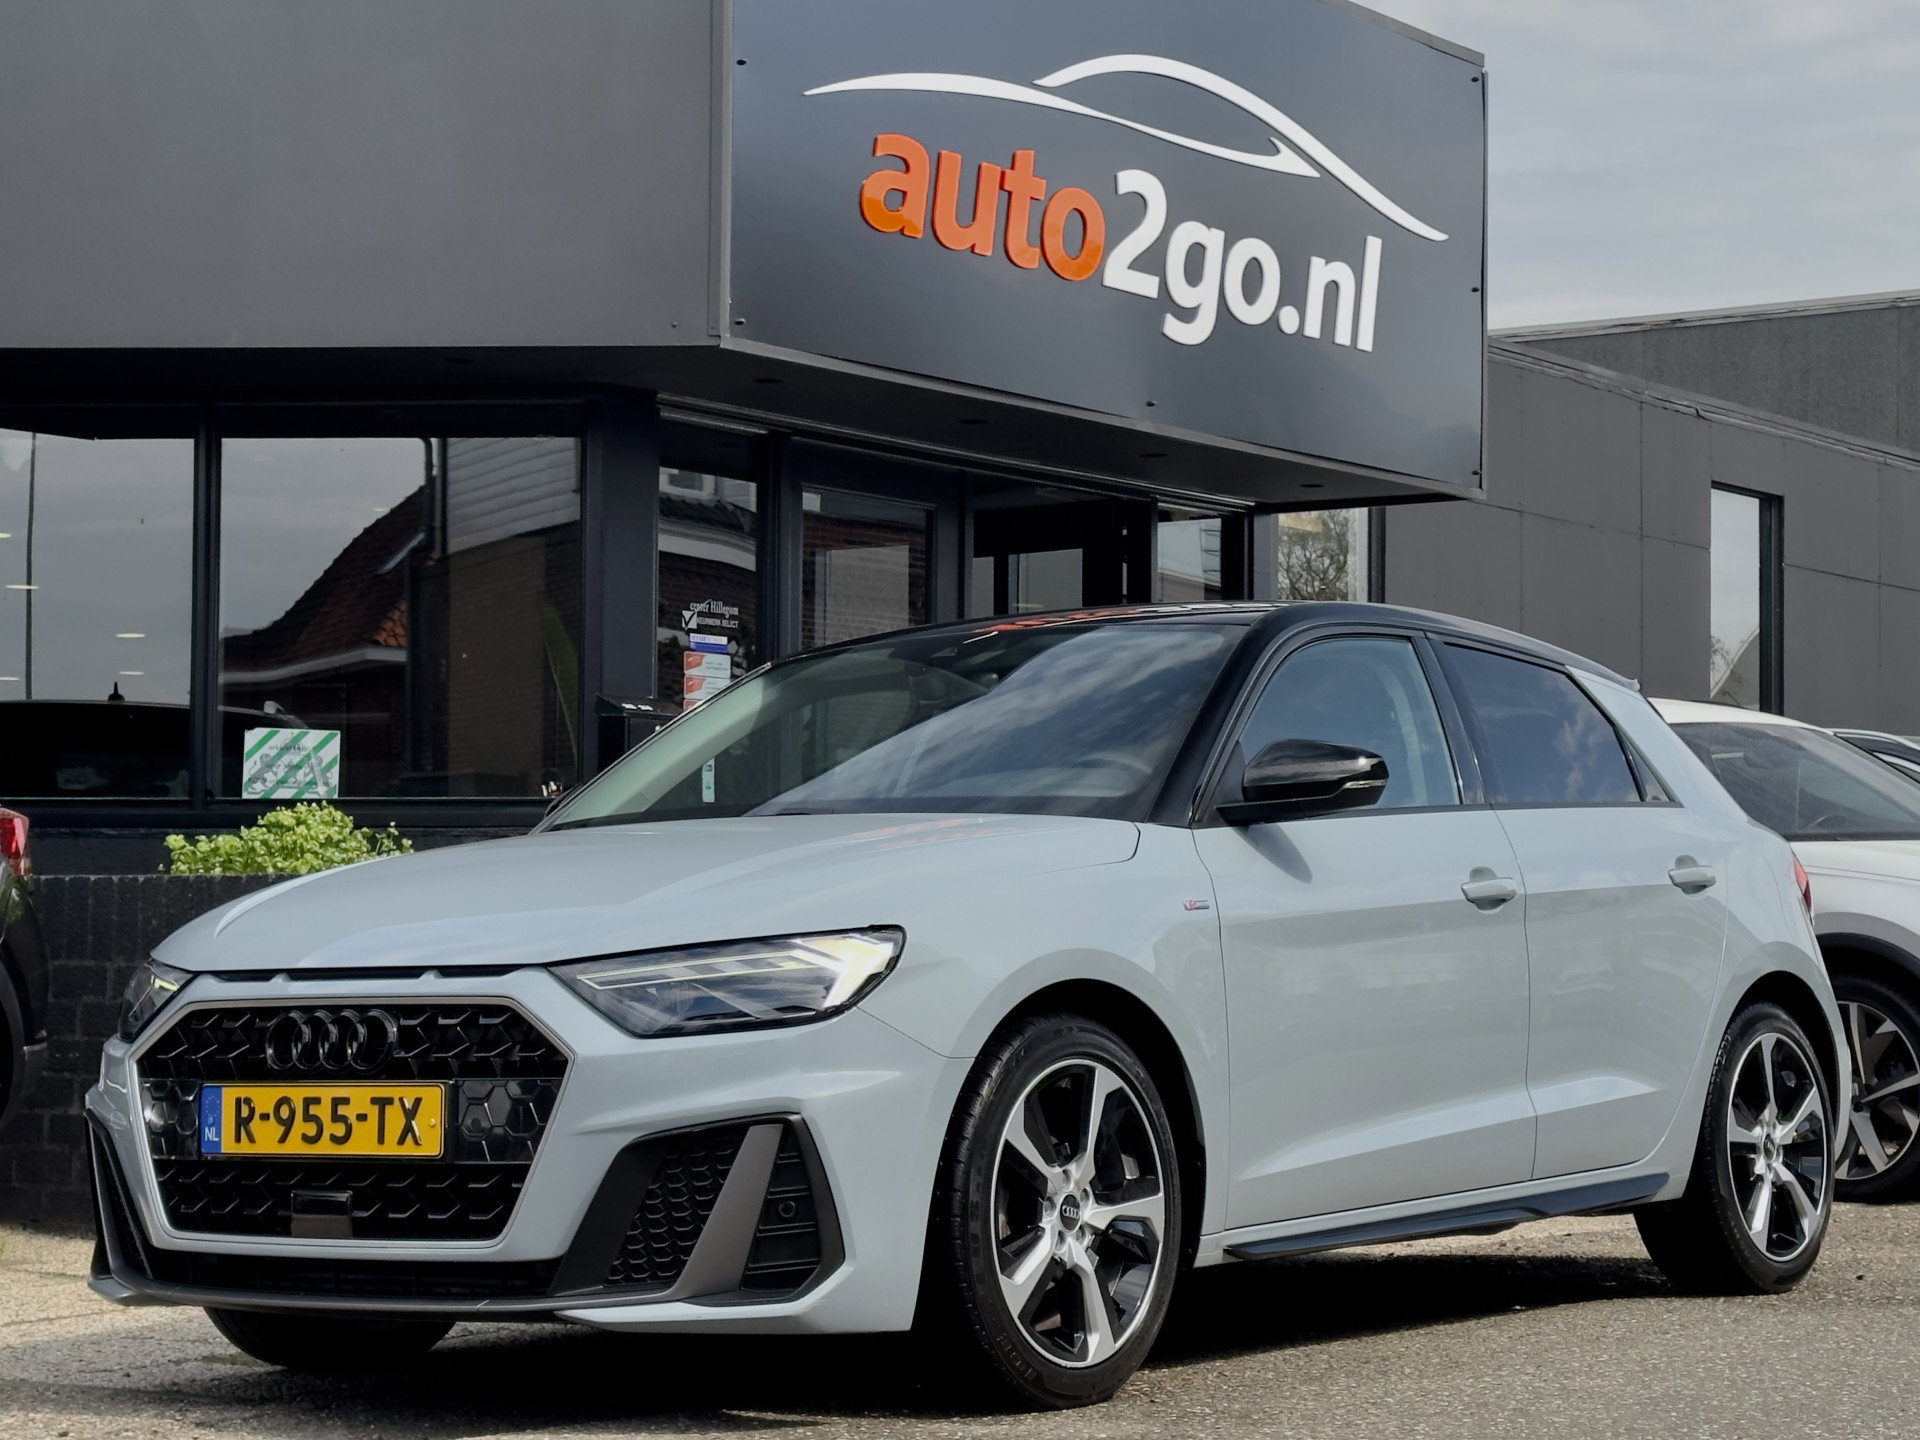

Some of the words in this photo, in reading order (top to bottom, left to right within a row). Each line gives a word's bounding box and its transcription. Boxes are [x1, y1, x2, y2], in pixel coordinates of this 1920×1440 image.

[859, 132, 1383, 353] auto2go.nl
[710, 600, 739, 619] Hillegom
[204, 1127, 219, 1141] NL
[234, 1096, 422, 1146] R-955-TX
